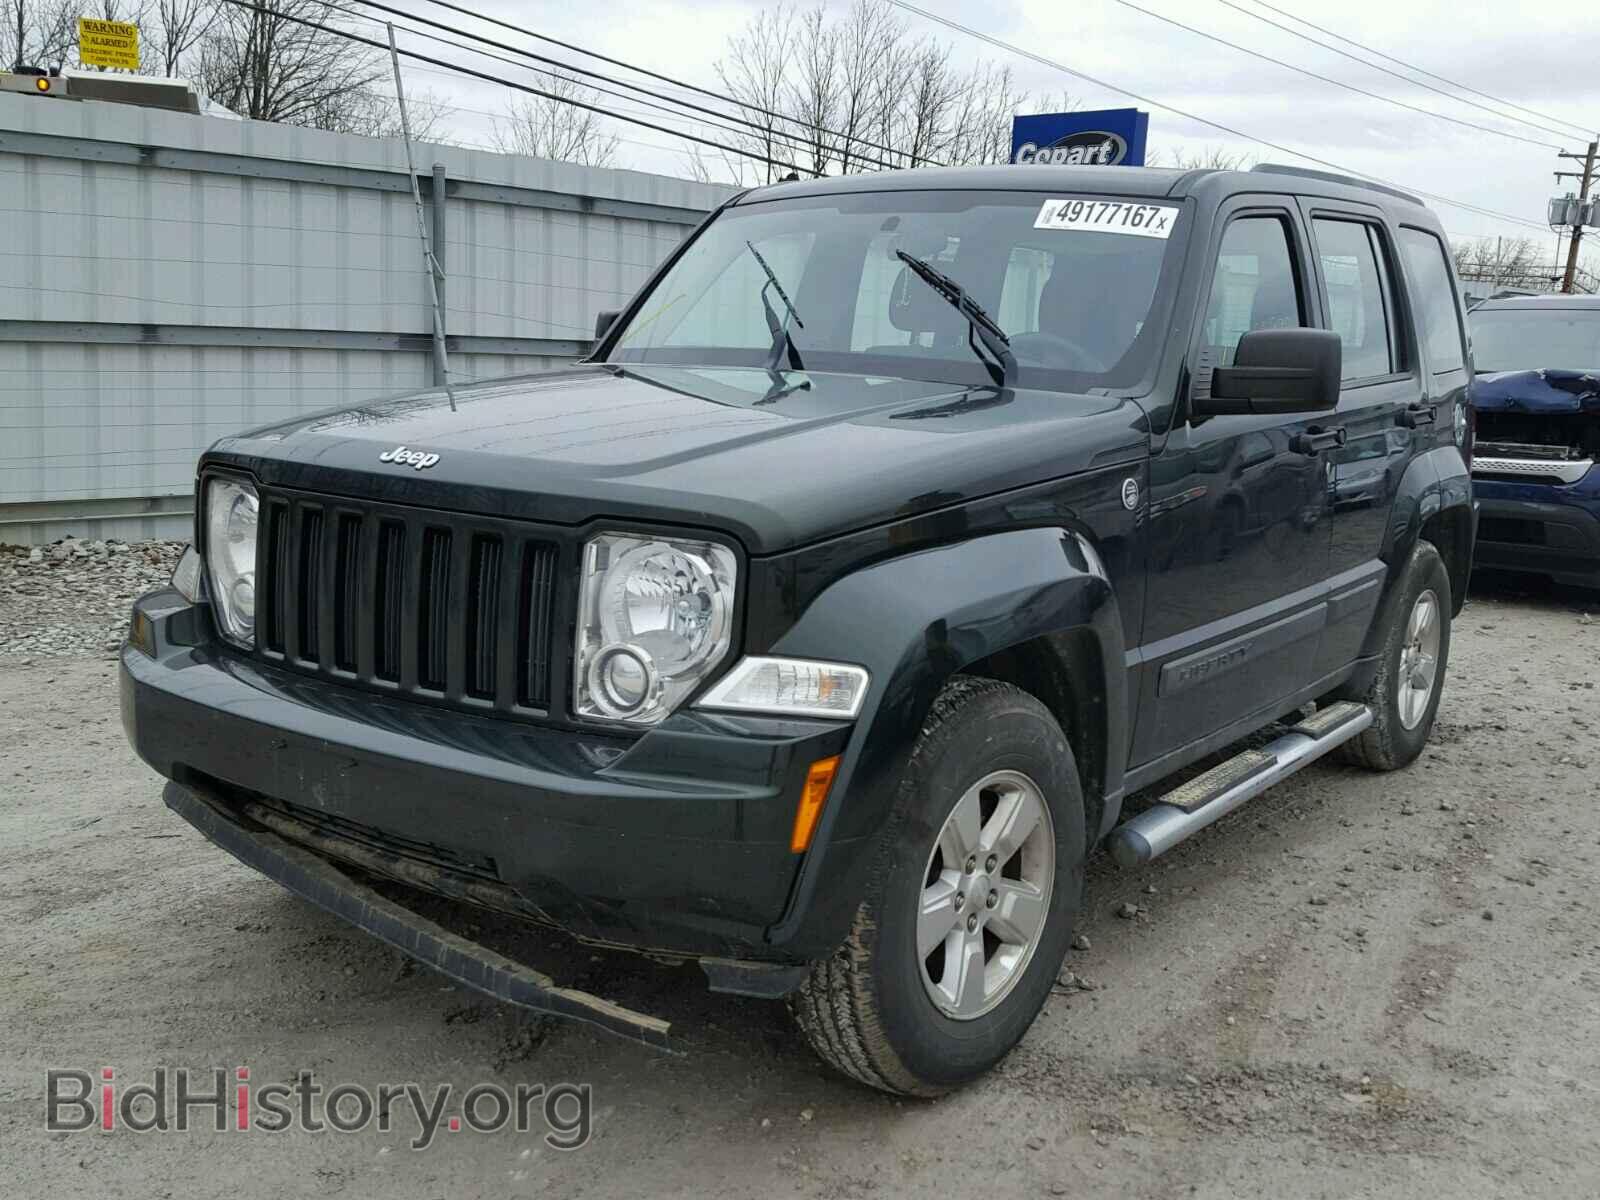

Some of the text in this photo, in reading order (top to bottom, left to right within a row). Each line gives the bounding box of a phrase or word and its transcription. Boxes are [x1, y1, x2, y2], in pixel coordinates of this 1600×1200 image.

[83, 21, 133, 36] WARNING
[91, 37, 128, 48] ALARMED
[1016, 140, 1112, 165] Copart
[379, 446, 441, 471] Jeep
